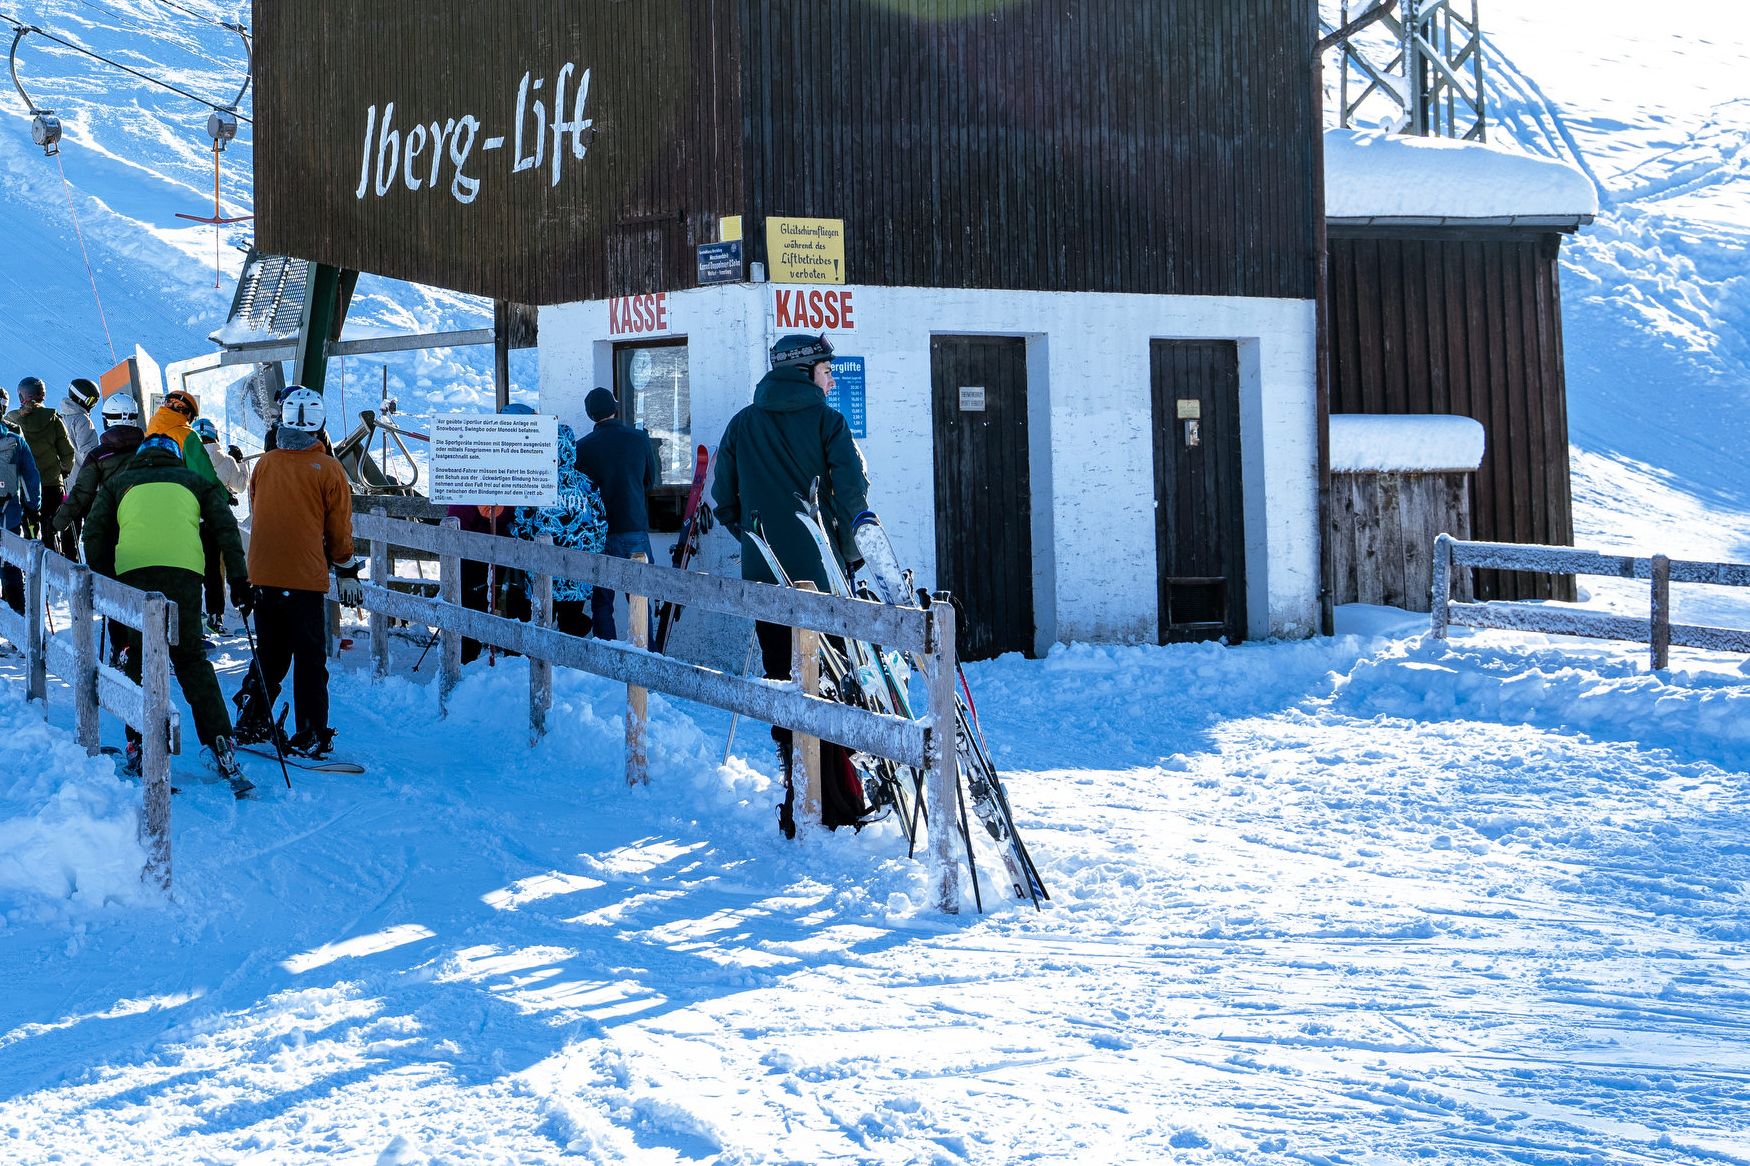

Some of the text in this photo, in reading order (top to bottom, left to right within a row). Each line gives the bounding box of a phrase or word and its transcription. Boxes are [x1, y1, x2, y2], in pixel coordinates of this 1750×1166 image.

[356, 62, 593, 204] Iberg-Lift
[780, 222, 839, 238] Gleitschirmfliegen
[784, 240, 826, 250] während des
[781, 253, 832, 267] Liftbetriebes
[790, 269, 826, 279] verboten
[609, 293, 667, 335] KASSE
[776, 290, 854, 329] KASSE
[830, 362, 861, 374] erglifte
